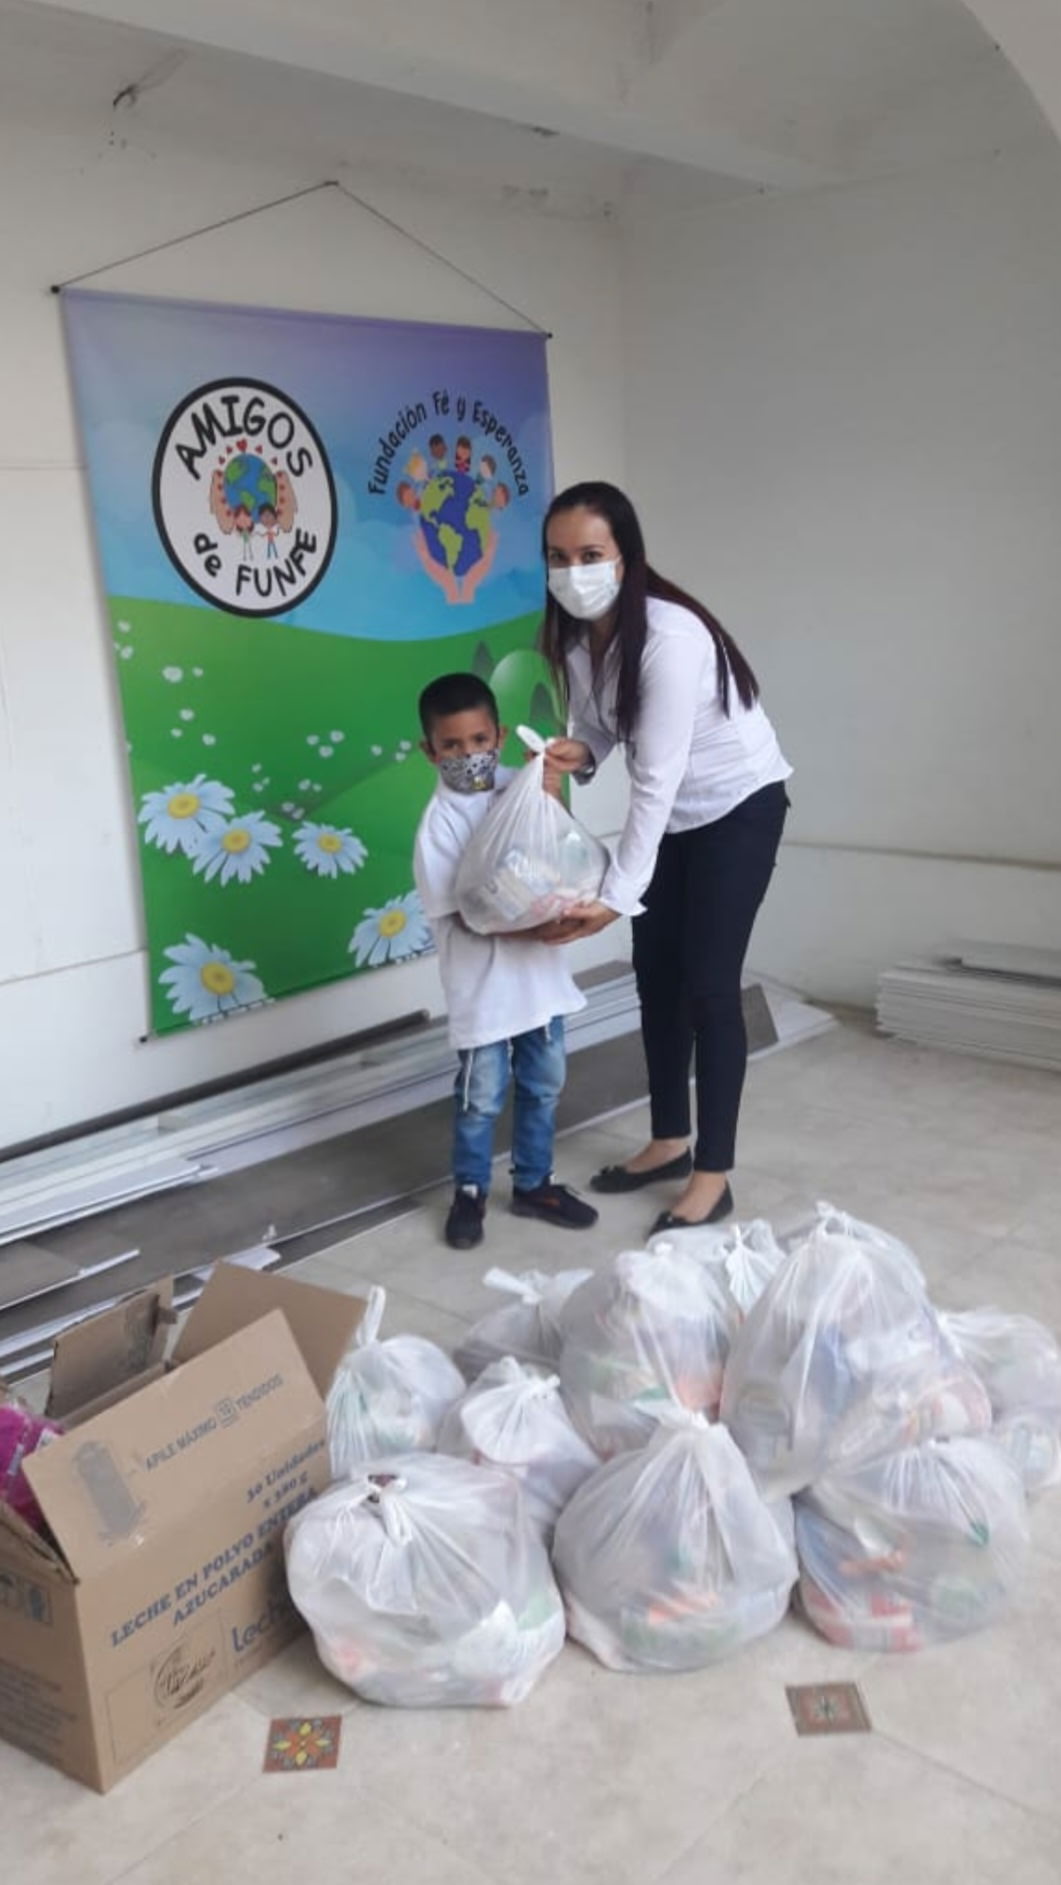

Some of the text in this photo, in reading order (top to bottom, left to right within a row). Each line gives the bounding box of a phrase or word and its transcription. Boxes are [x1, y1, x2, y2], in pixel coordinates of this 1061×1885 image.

[175, 395, 314, 481] AMIGOS
[367, 401, 428, 496] Fundación
[456, 397, 467, 422] y
[472, 400, 530, 497] Esperanza
[193, 528, 318, 597] de FUNFE
[110, 1593, 173, 1647] LECHE
[174, 1572, 199, 1601] EN
[202, 1532, 255, 1581] POLVO
[172, 1541, 276, 1626] AZUCARADA
